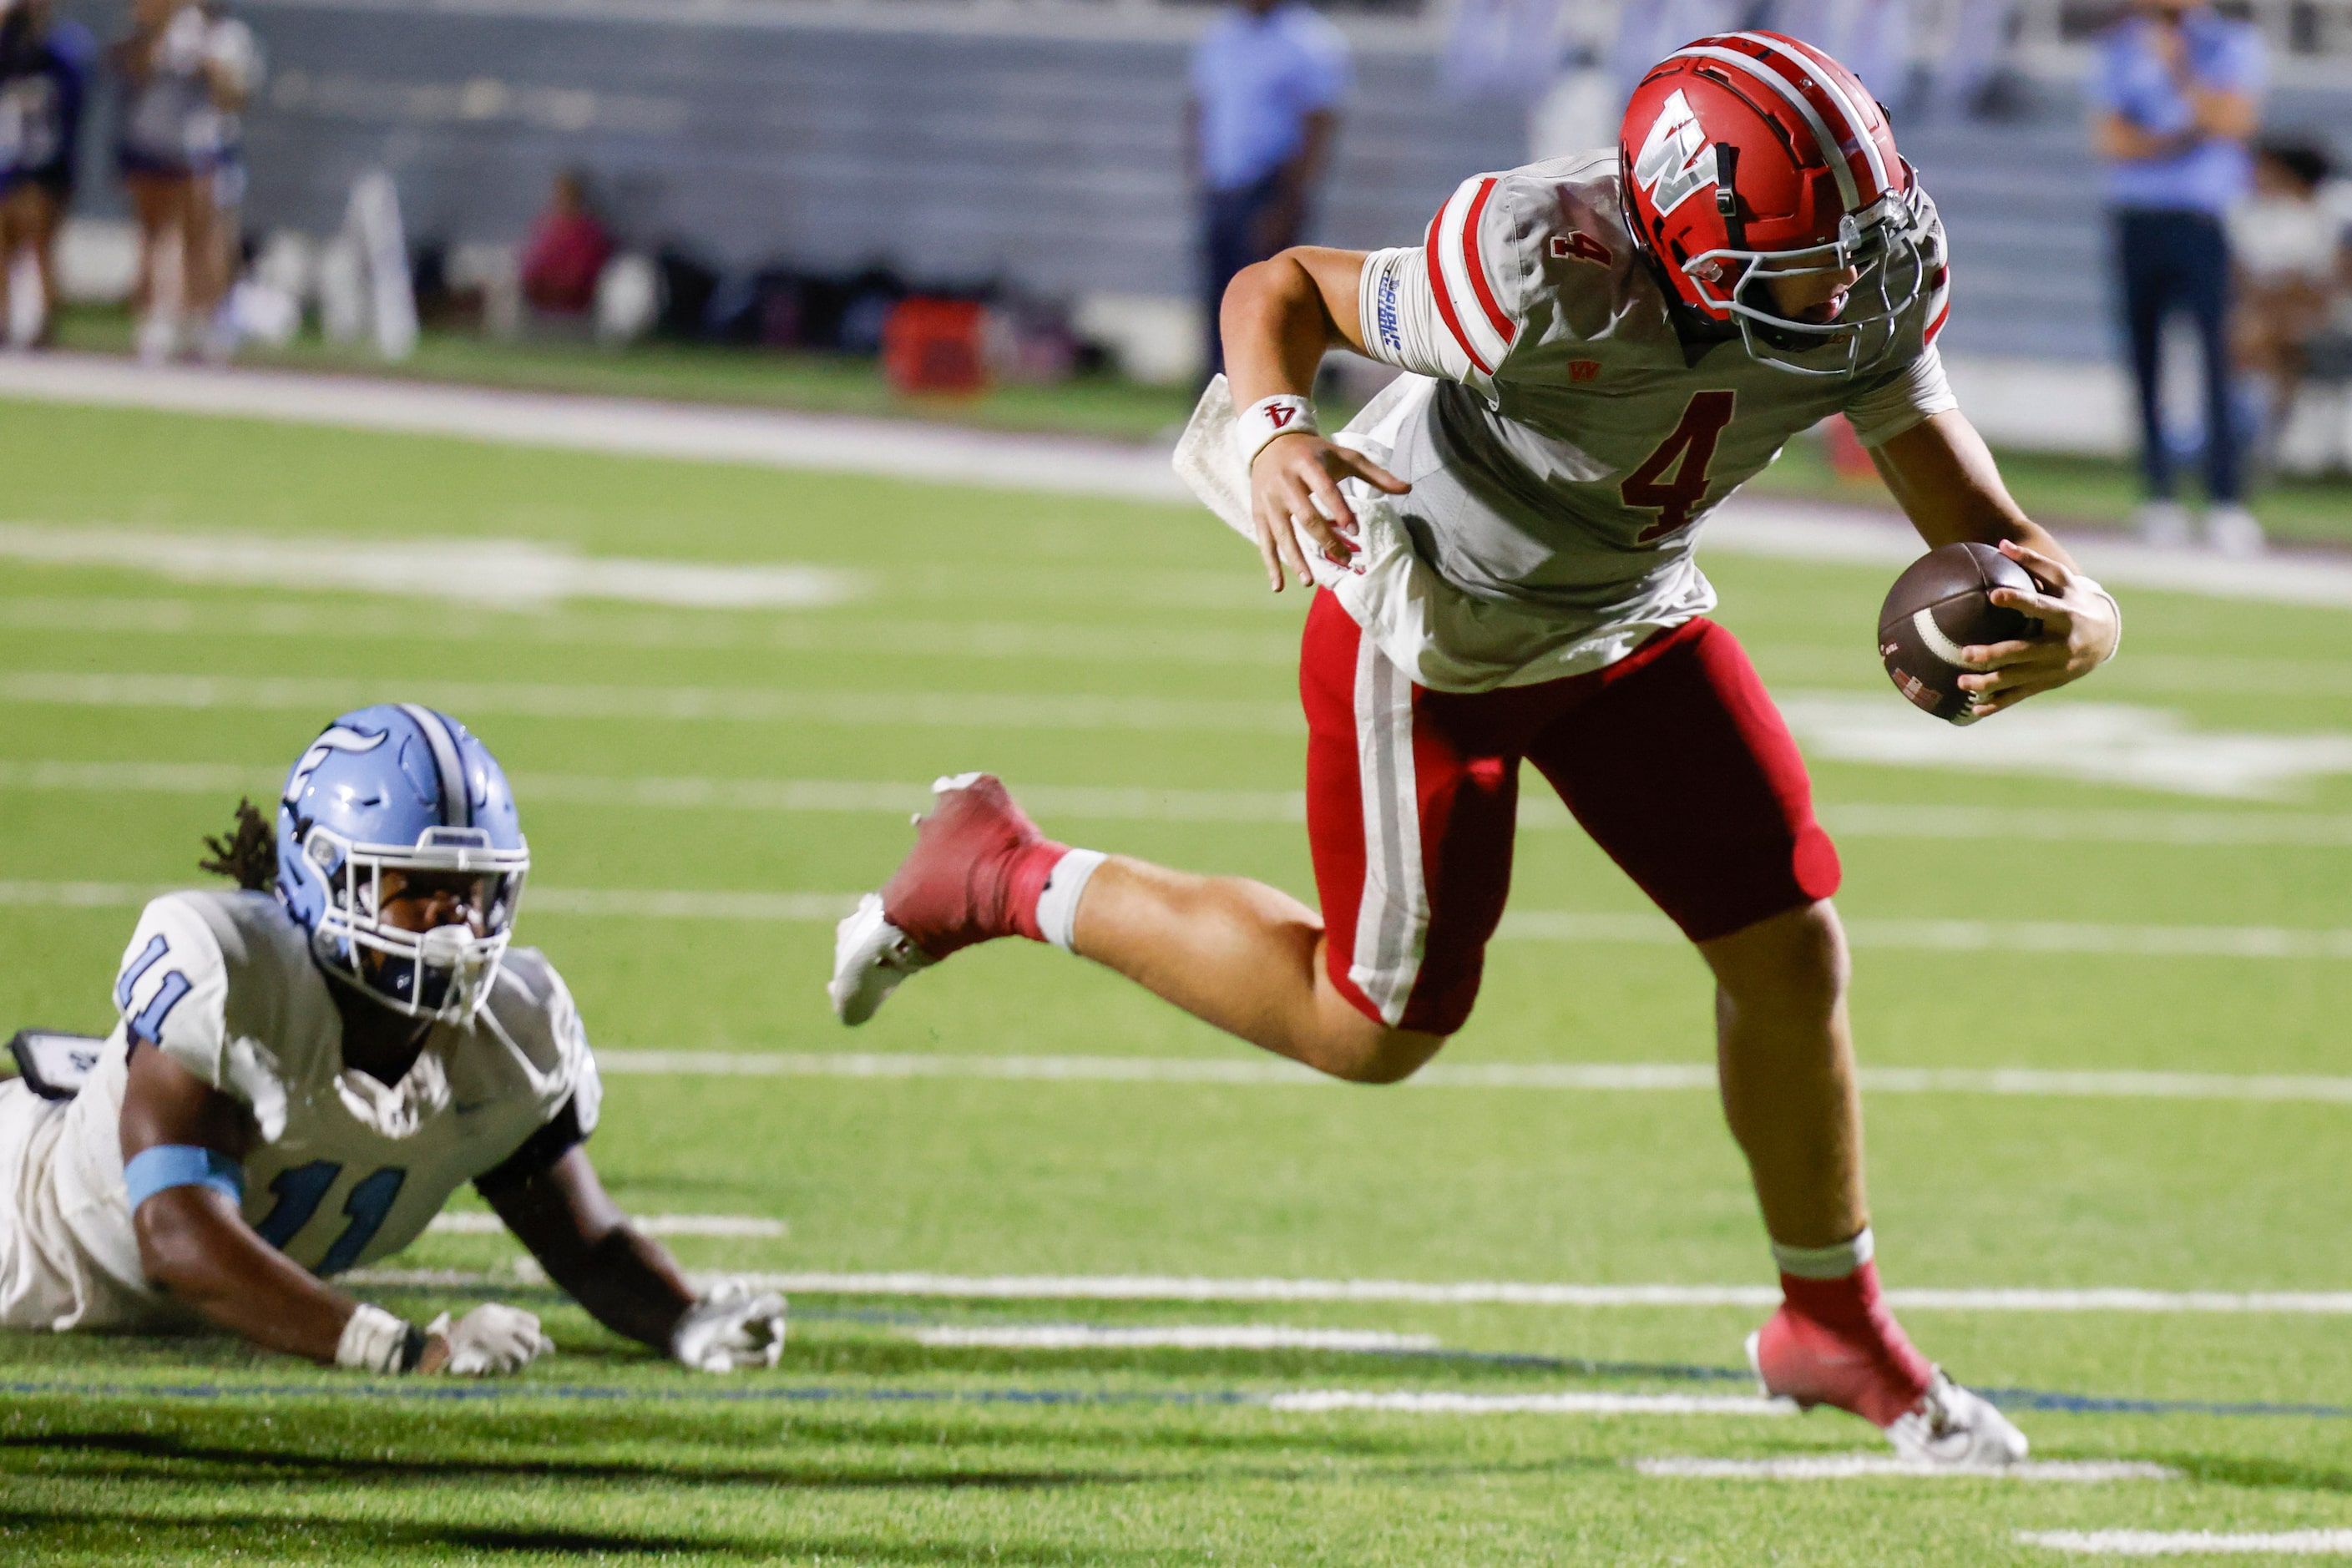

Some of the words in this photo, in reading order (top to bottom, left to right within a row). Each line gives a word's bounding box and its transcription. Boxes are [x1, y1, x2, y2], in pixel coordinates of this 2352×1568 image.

[1550, 230, 1613, 270] 4
[1567, 360, 1602, 383] W
[1263, 402, 1297, 429] 4
[1618, 389, 1737, 544] 4
[118, 934, 192, 1044] 11
[255, 1160, 407, 1274] 11
